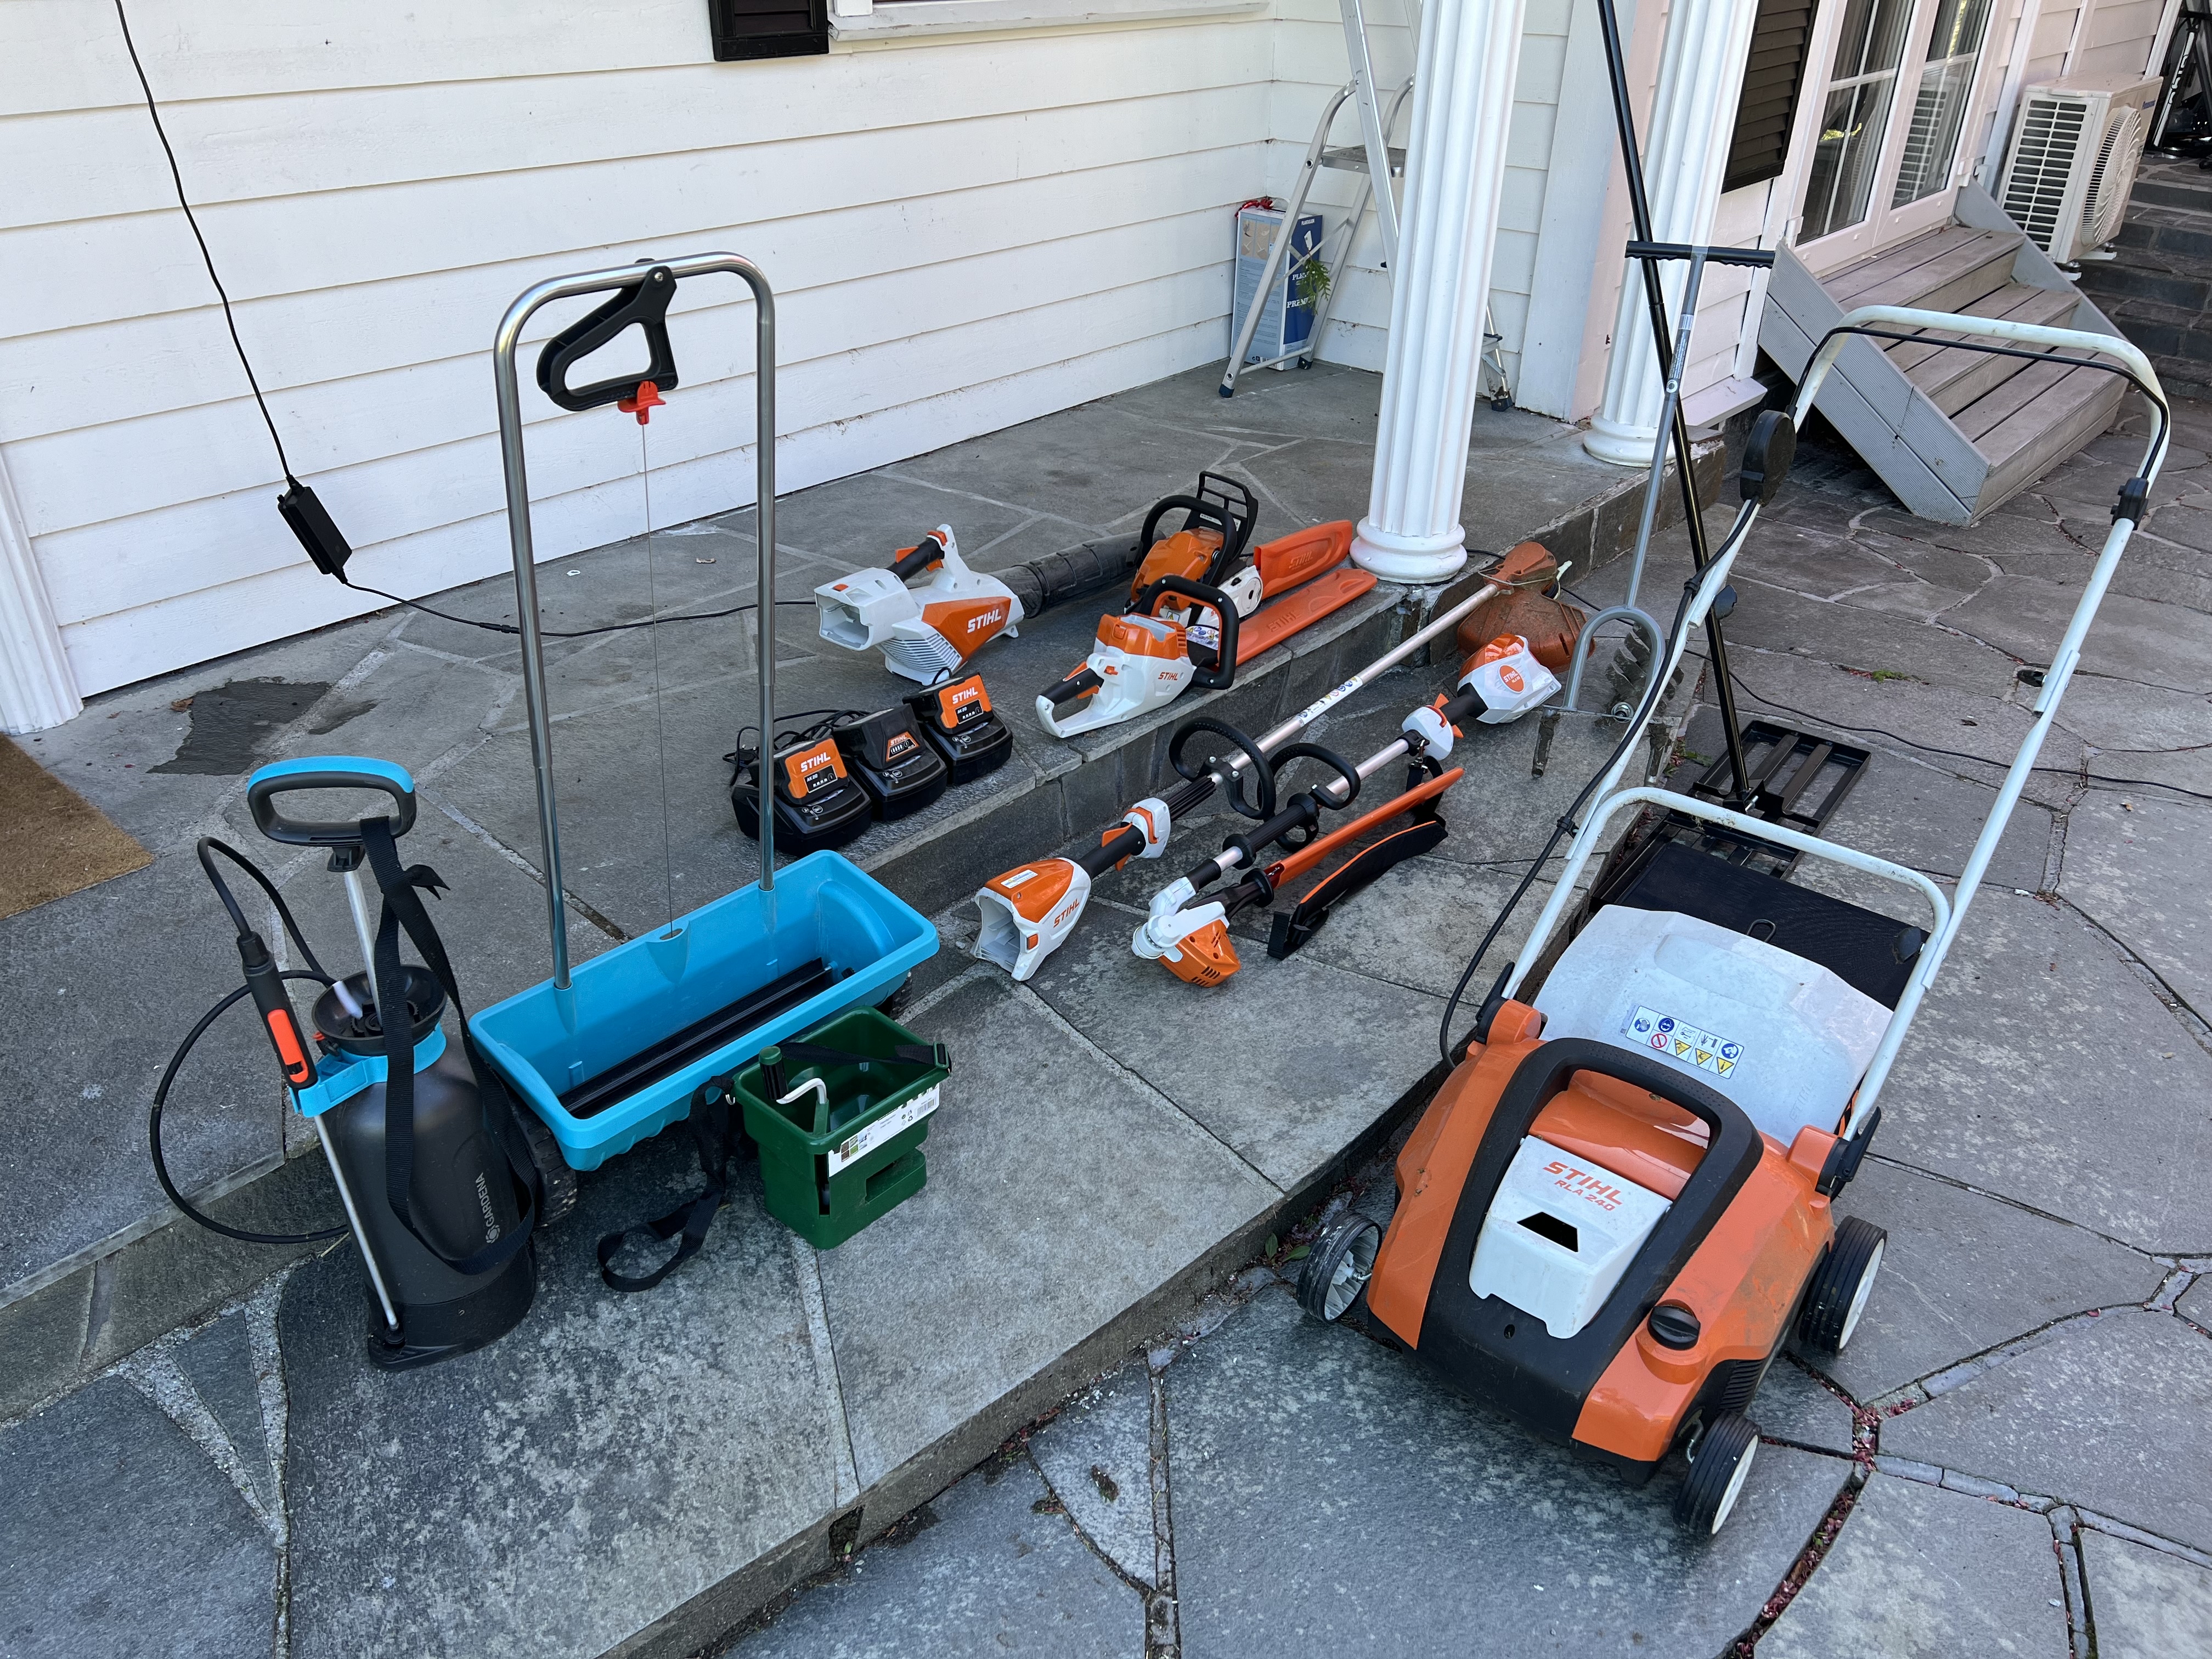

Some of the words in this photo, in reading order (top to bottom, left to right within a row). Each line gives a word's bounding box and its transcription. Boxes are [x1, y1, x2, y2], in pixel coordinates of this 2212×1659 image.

[967, 608, 1002, 634] STIHL
[1266, 612, 1300, 632] STIHL
[1158, 672, 1178, 680] STIHL
[1503, 670, 1519, 683] STIHL
[952, 687, 978, 704] STIHL
[890, 735, 907, 746] STIHL
[800, 752, 831, 772] STIHL
[1053, 899, 1080, 928] STIHL
[1543, 1161, 1623, 1205] STIHL
[475, 1172, 494, 1227] GARDENA
[1554, 1180, 1583, 1196] RLA
[1585, 1194, 1615, 1211] 240
